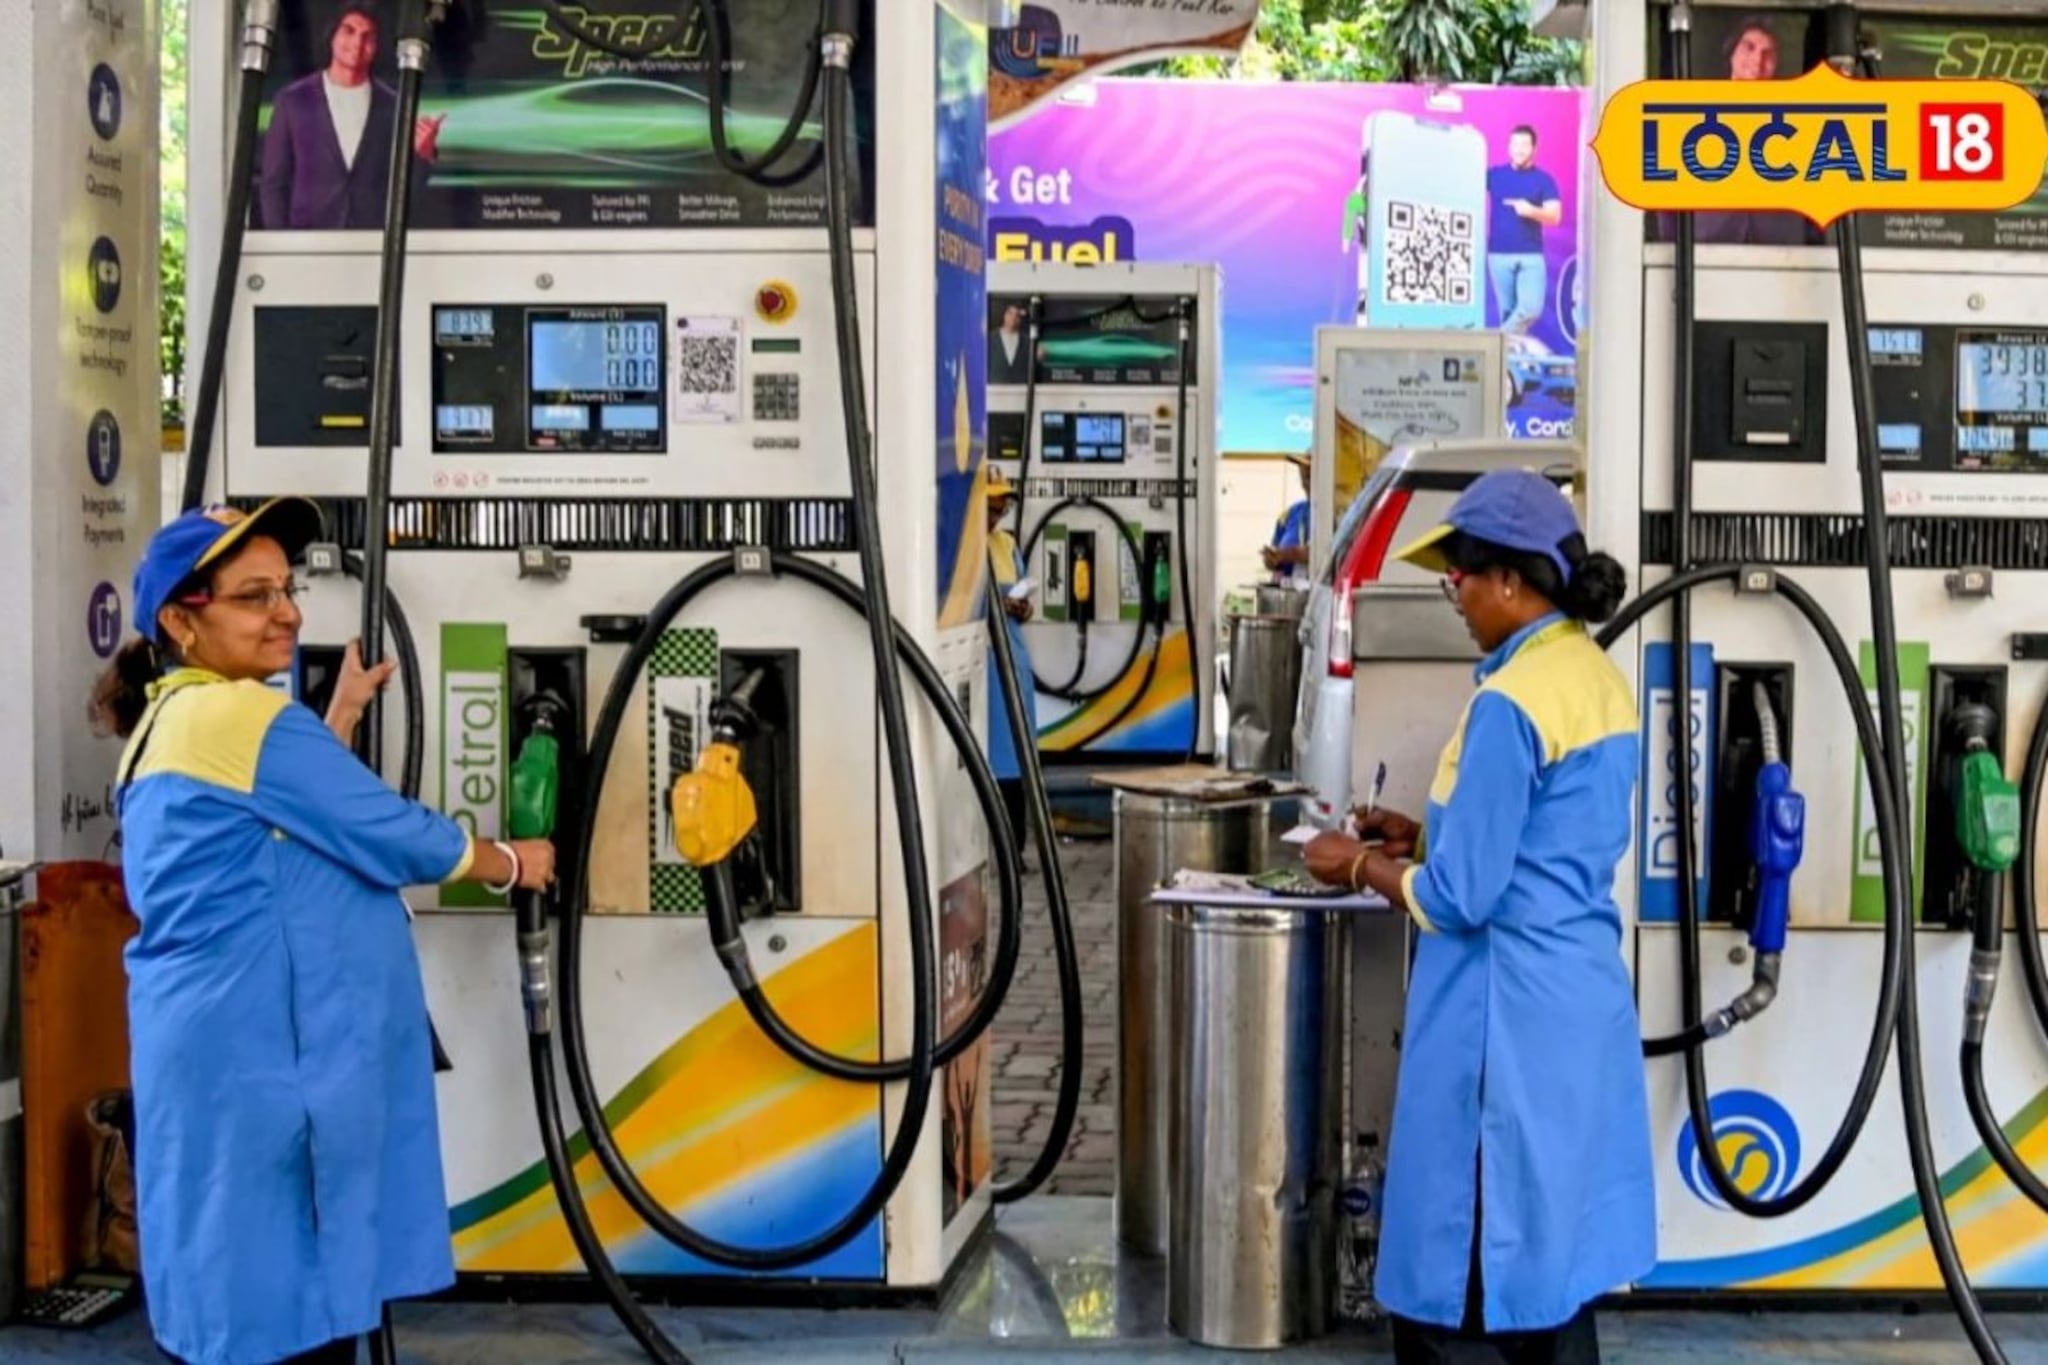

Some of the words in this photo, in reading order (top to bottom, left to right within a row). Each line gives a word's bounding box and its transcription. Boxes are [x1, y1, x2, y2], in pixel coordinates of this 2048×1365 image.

[587, 60, 616, 76] High
[618, 59, 702, 72] Performance
[1935, 32, 2048, 85] Spe
[1011, 165, 1072, 205] Get
[996, 232, 1117, 263] Fuel
